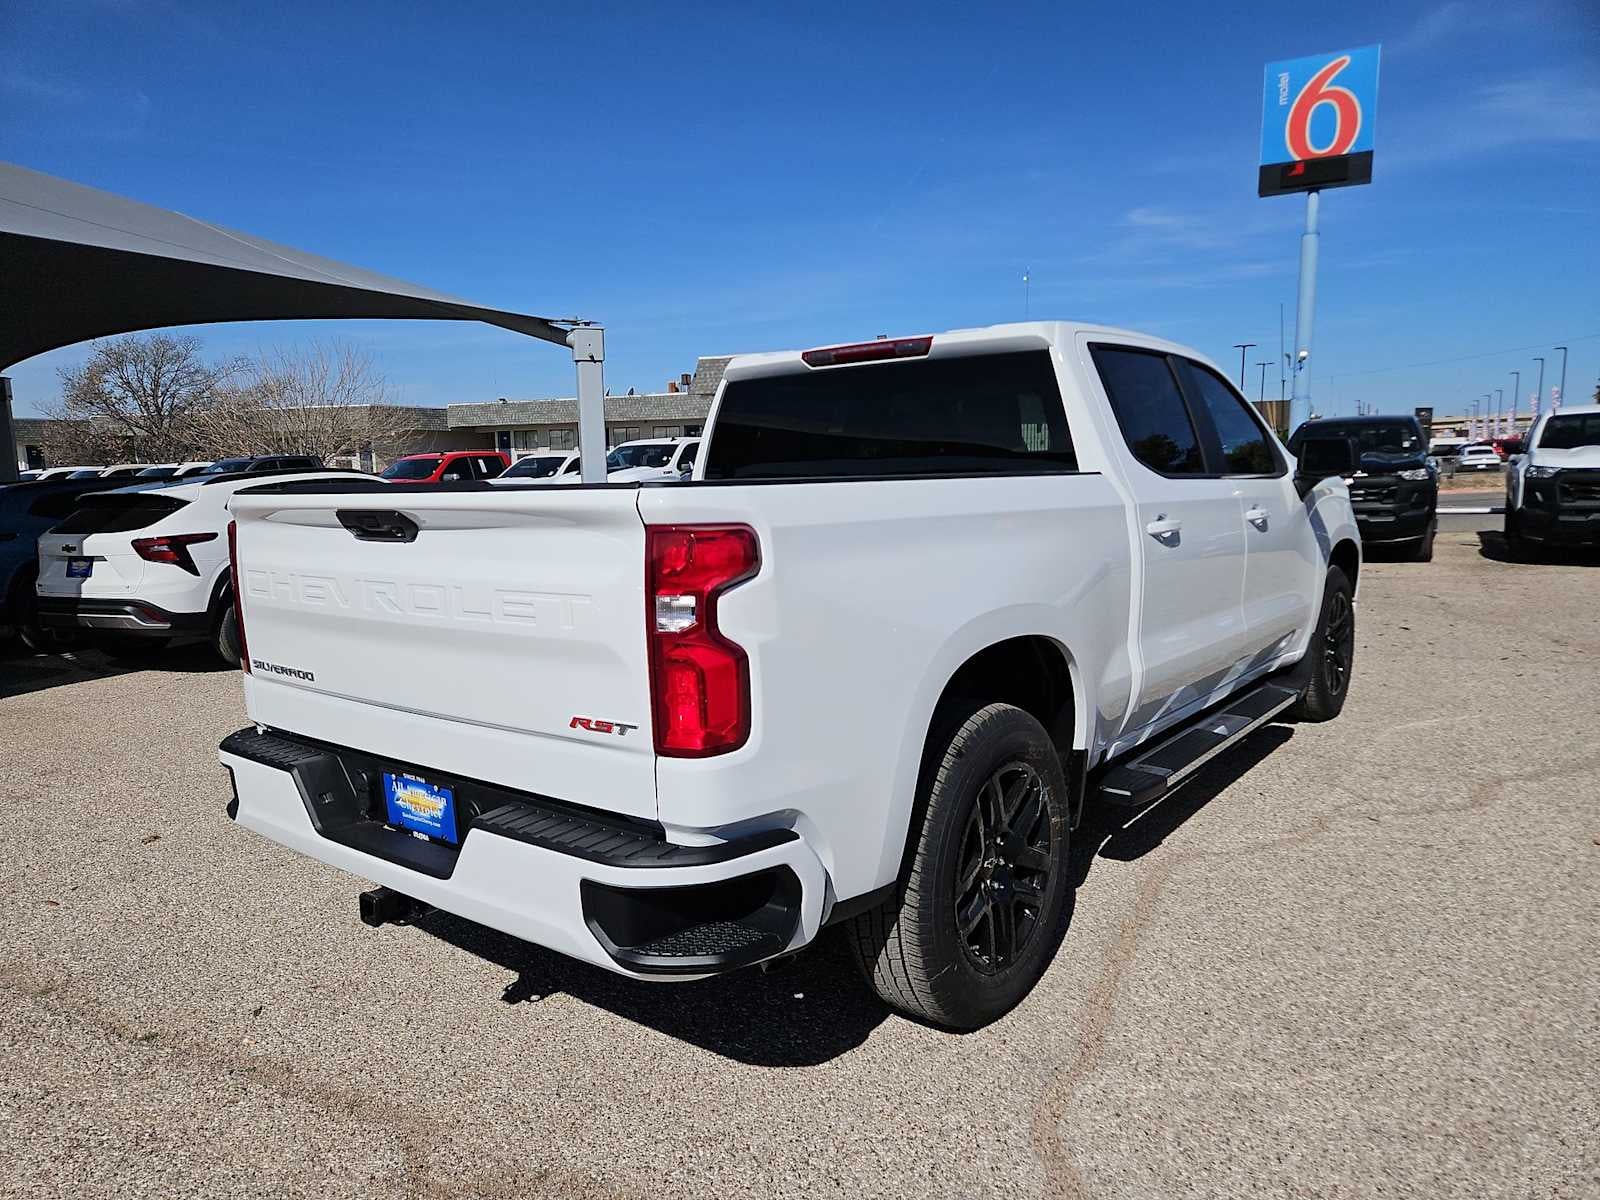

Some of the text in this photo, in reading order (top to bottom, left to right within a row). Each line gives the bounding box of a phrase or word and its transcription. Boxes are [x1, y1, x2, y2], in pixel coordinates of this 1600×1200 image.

[1278, 72, 1290, 106] motel
[1285, 54, 1362, 162] 6
[247, 569, 593, 630] CHEVROLET
[251, 659, 316, 682] SILVERADO
[569, 716, 639, 736] RST
